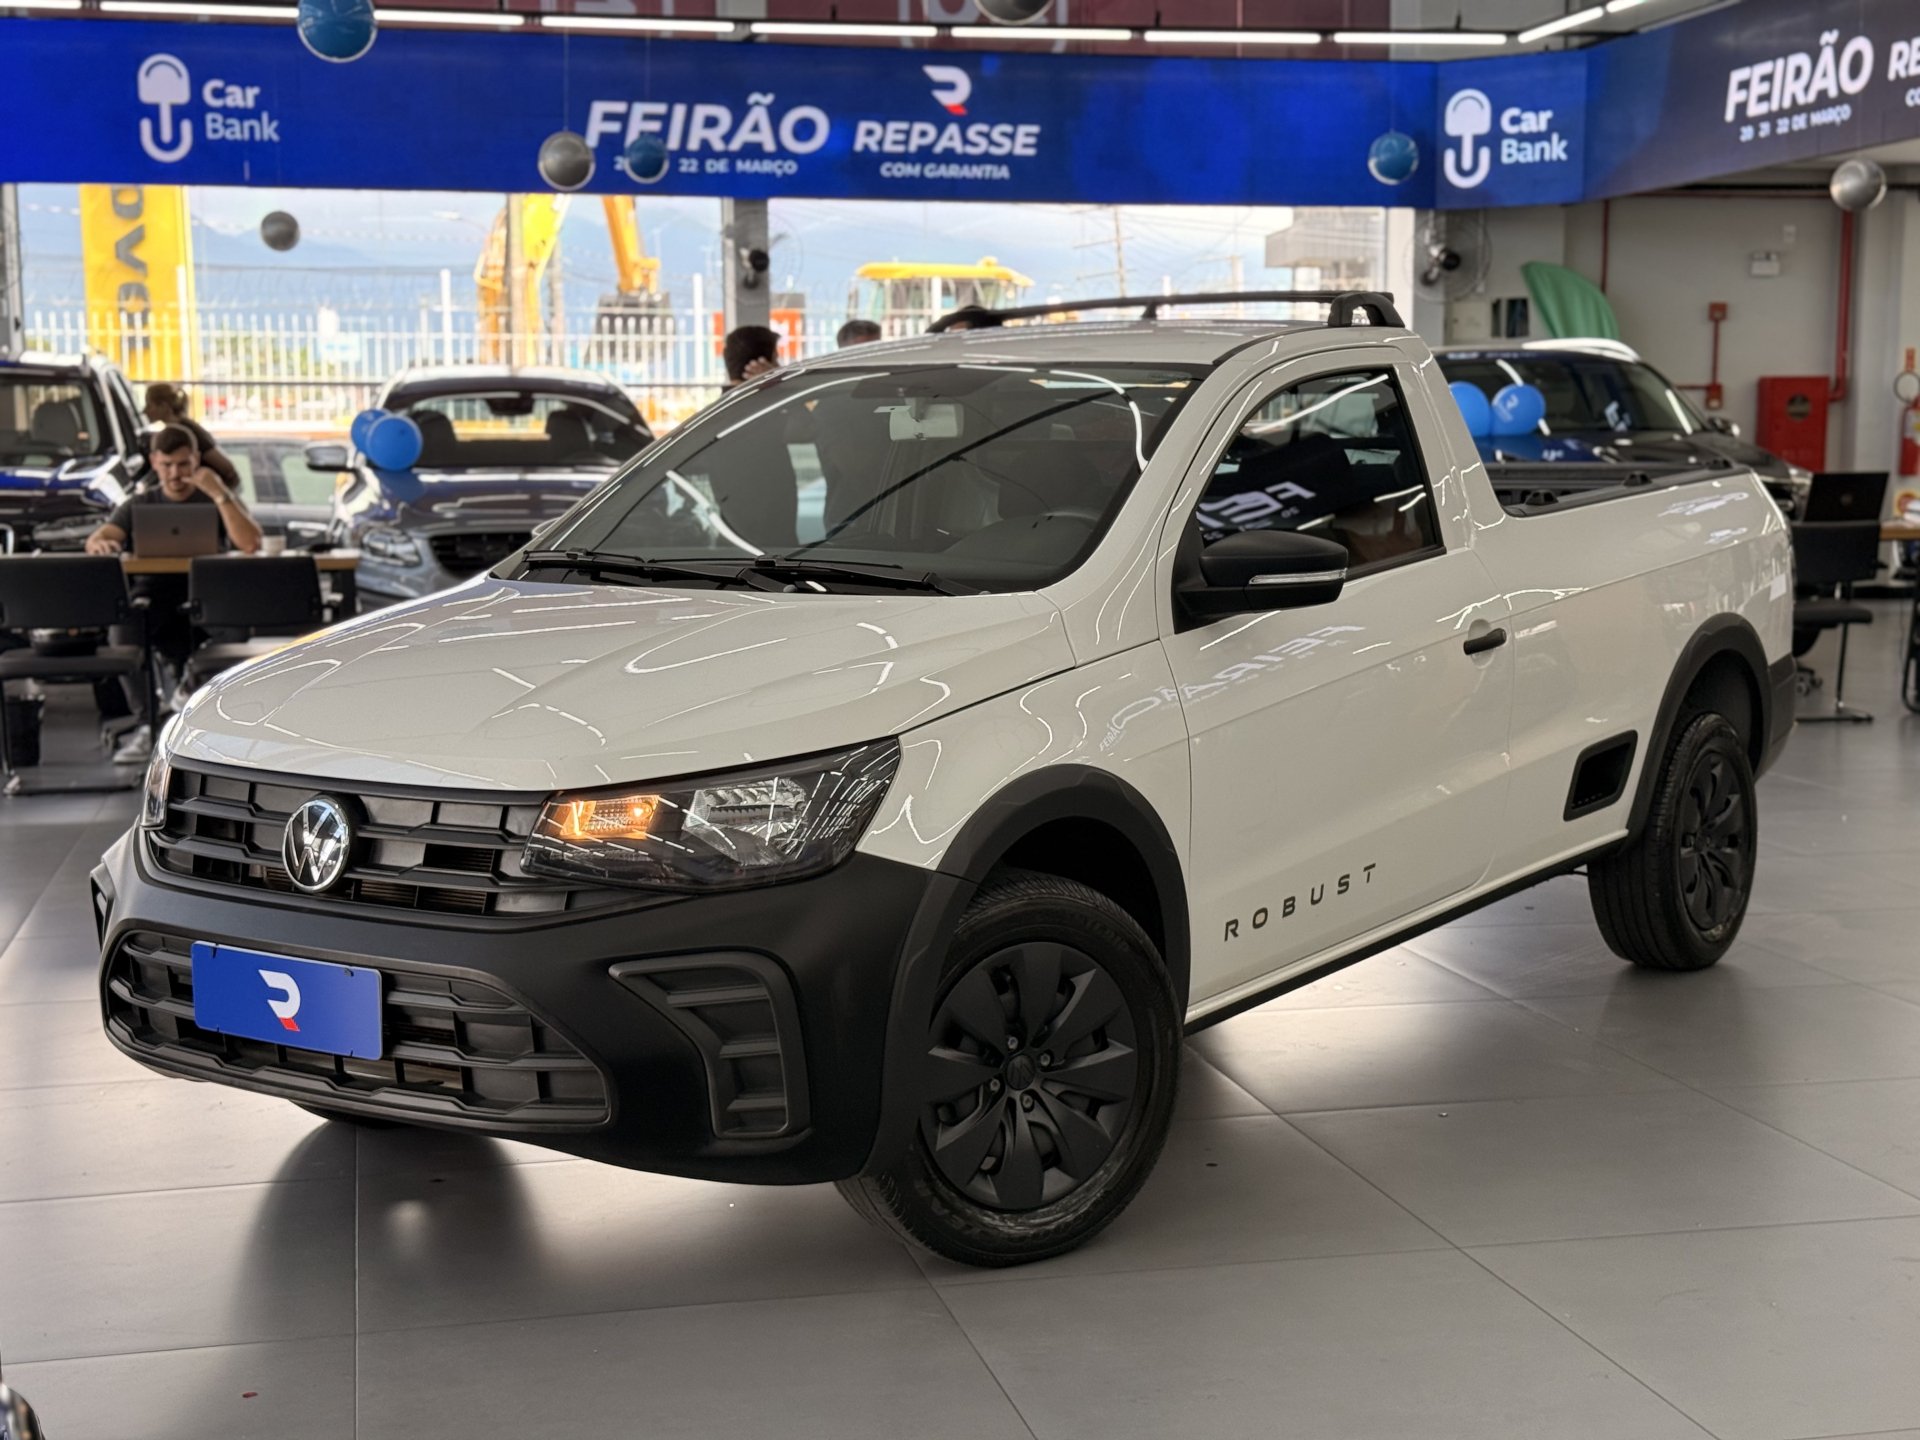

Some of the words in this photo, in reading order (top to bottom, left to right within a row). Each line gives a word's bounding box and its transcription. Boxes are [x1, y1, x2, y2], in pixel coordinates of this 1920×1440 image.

[1724, 28, 1874, 123] FEIRÃO
[202, 78, 261, 109] Car
[205, 110, 280, 142] Bank
[1500, 106, 1554, 134] Car
[853, 120, 1041, 156] REPASSE
[1501, 131, 1568, 165] Bank
[678, 157, 699, 174] 22
[704, 158, 729, 174] DE
[735, 158, 799, 177] MARÇO
[879, 162, 922, 179] COM
[923, 163, 1011, 180] GARANTIA
[1224, 863, 1376, 942] ROBUST
